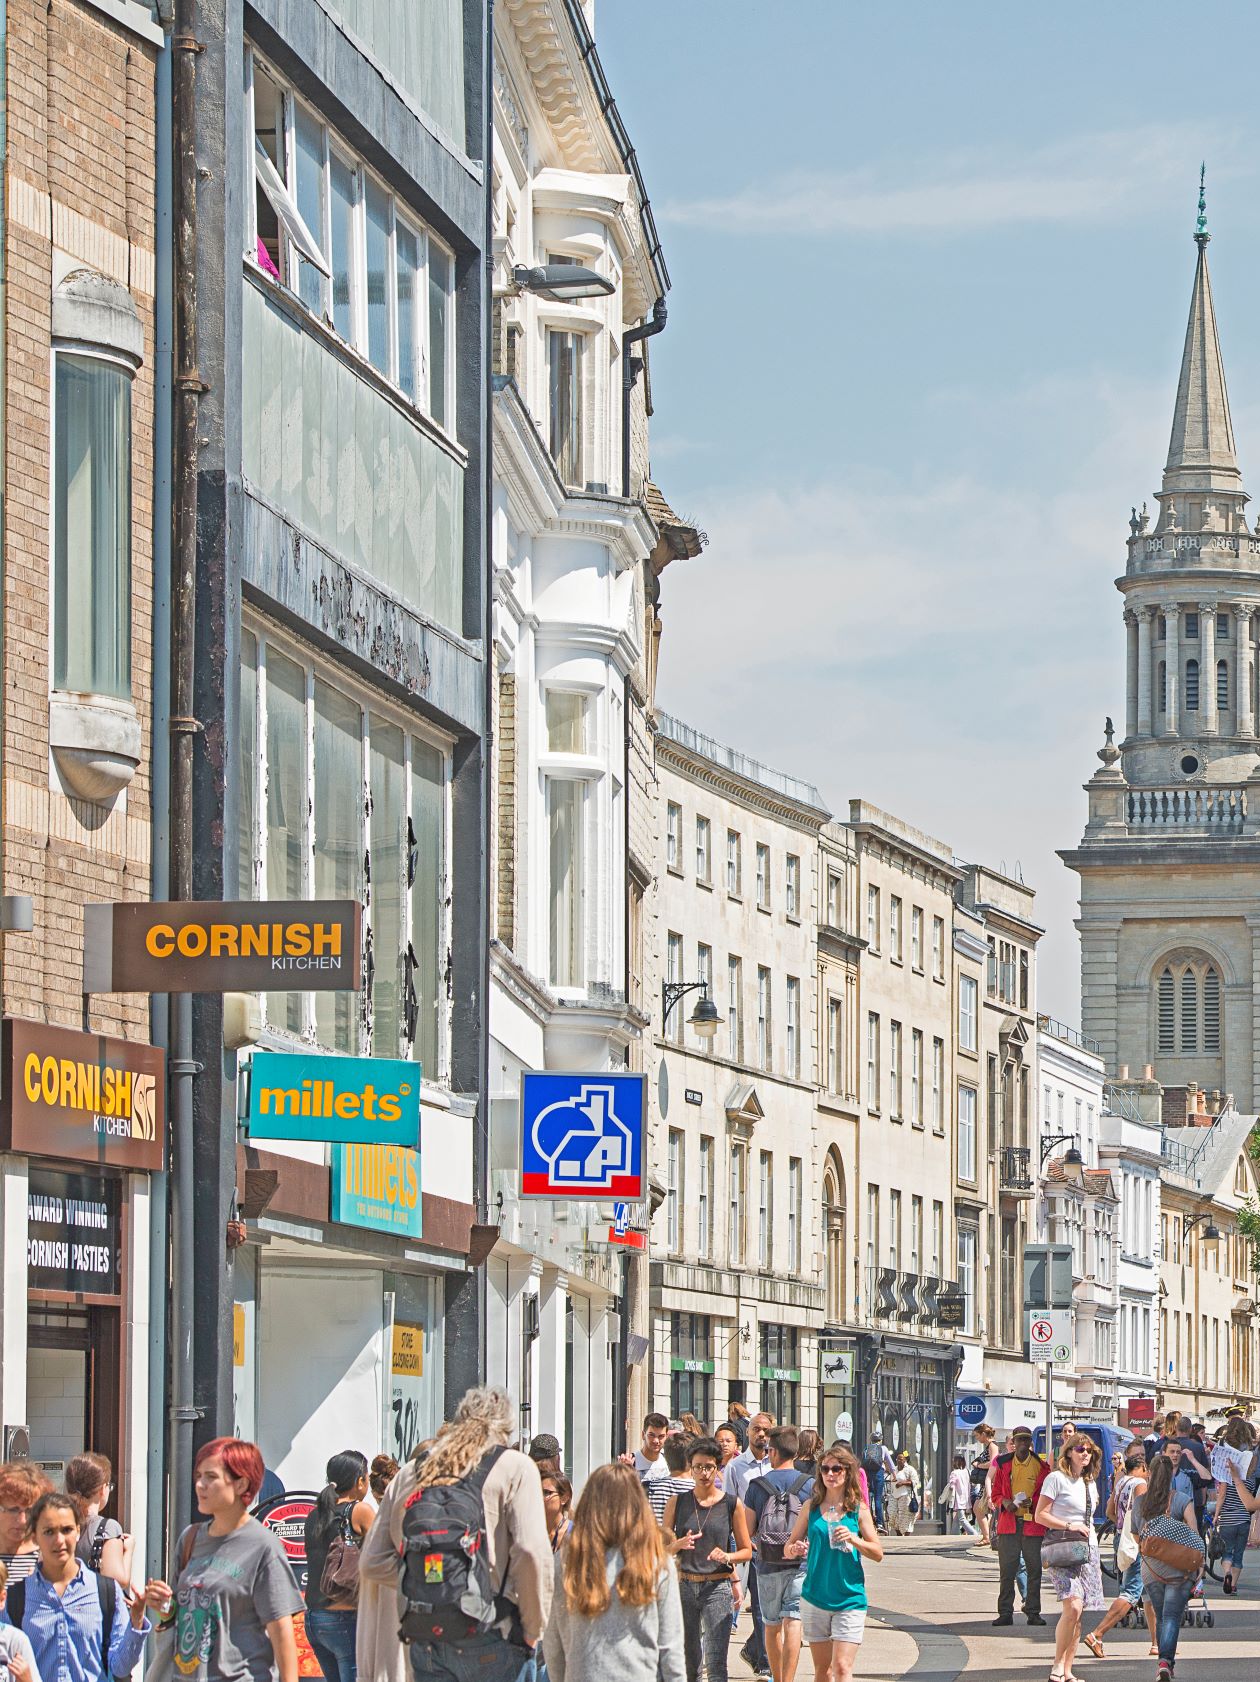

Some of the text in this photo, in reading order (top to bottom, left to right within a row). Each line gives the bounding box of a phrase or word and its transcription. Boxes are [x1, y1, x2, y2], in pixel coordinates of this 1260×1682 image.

[145, 923, 342, 958] CORNISH
[271, 957, 342, 970] KITCHEN
[24, 1052, 131, 1118] CORNISH
[259, 1080, 402, 1121] millets
[93, 1114, 131, 1138] KITCHEN
[28, 1194, 108, 1229] AWARD WINNING
[71, 1243, 110, 1274] PASTIES
[961, 1404, 983, 1413] REED
